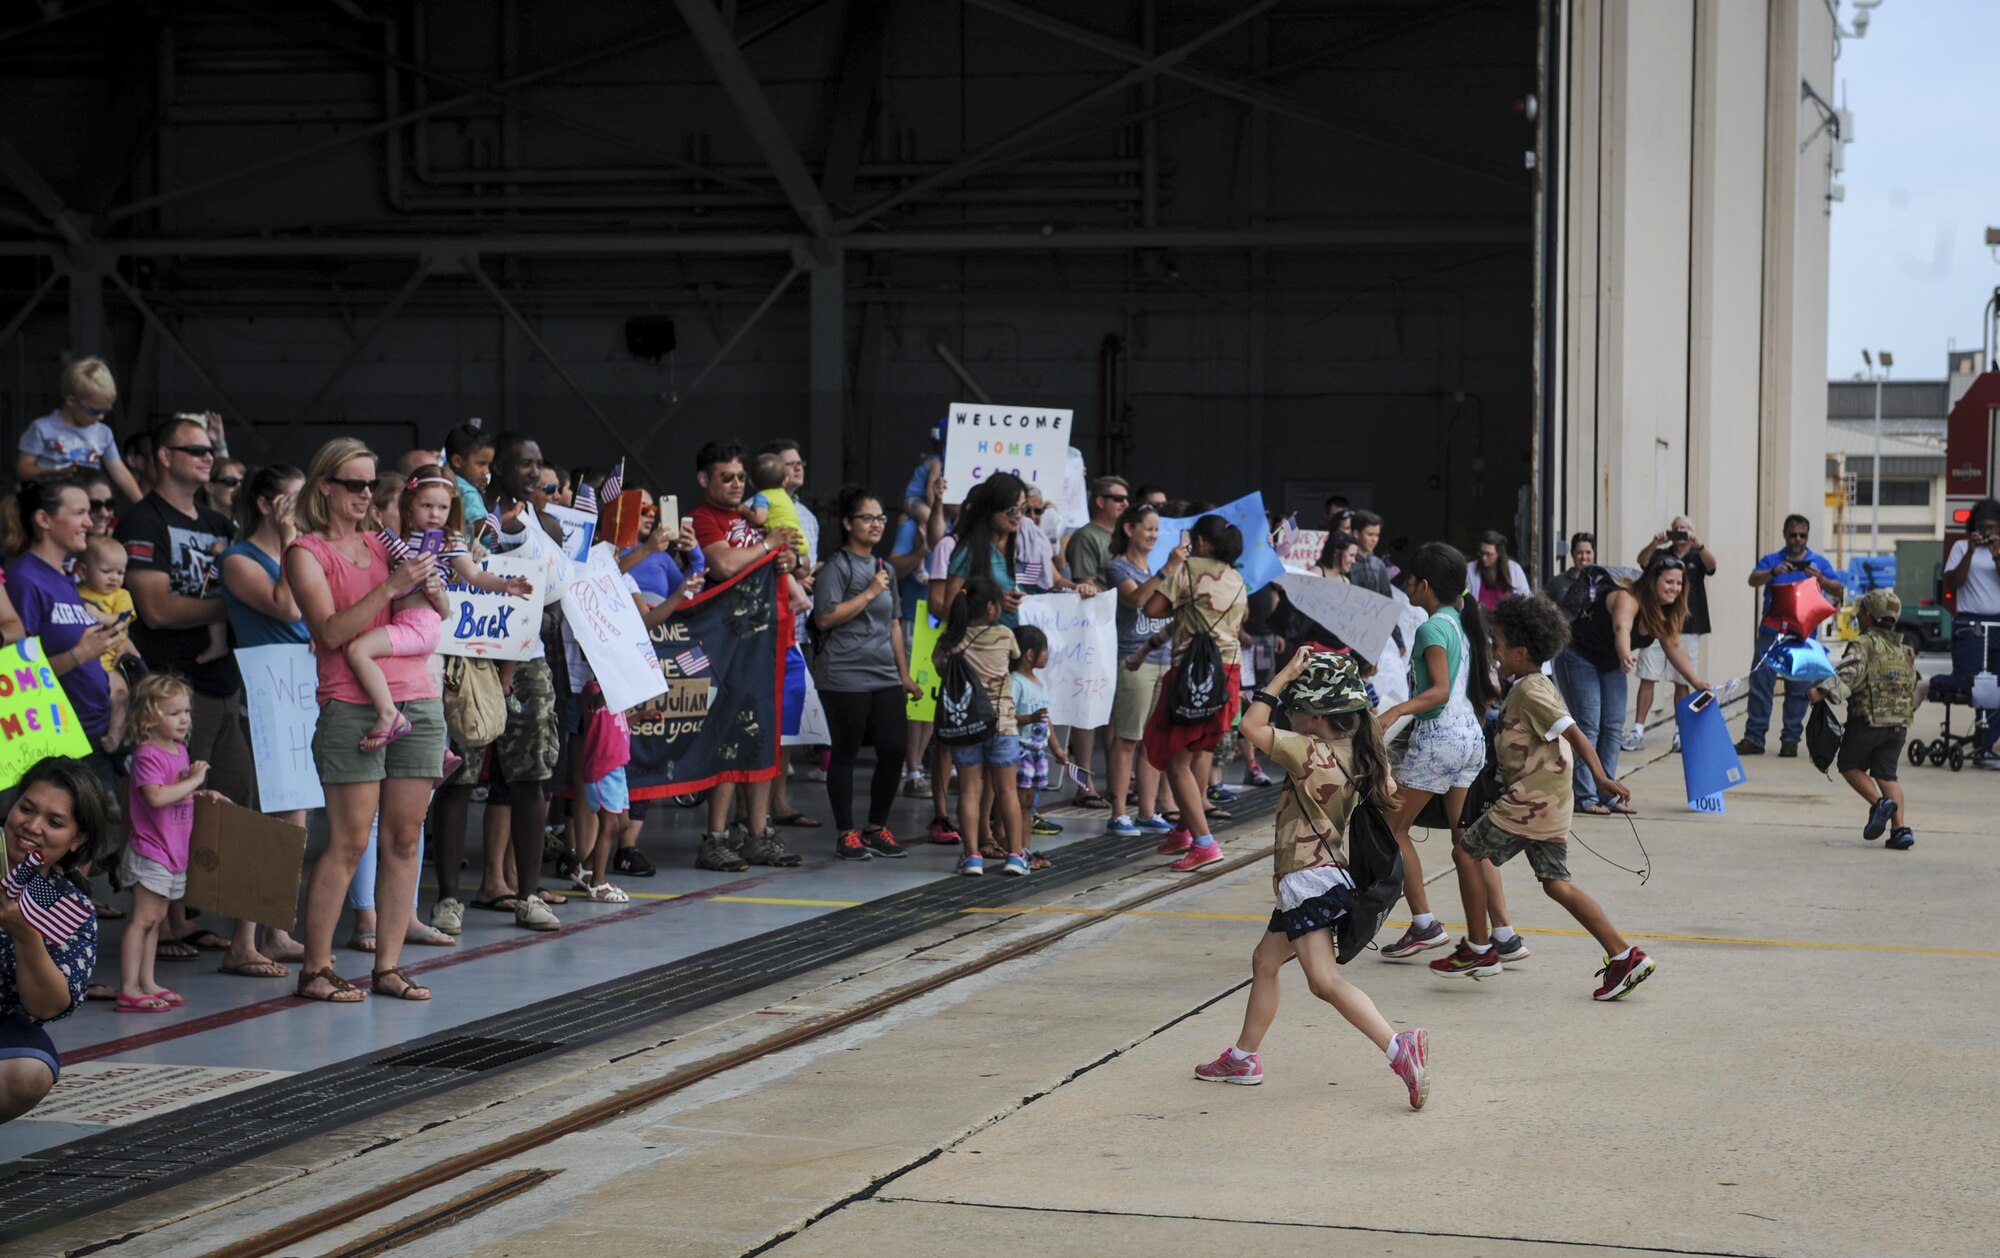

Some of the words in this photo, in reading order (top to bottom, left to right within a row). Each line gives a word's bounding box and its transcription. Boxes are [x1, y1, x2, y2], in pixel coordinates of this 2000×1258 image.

[955, 412, 1062, 429] WELCOME
[978, 441, 1033, 457] HOME
[51, 602, 78, 624] AIR
